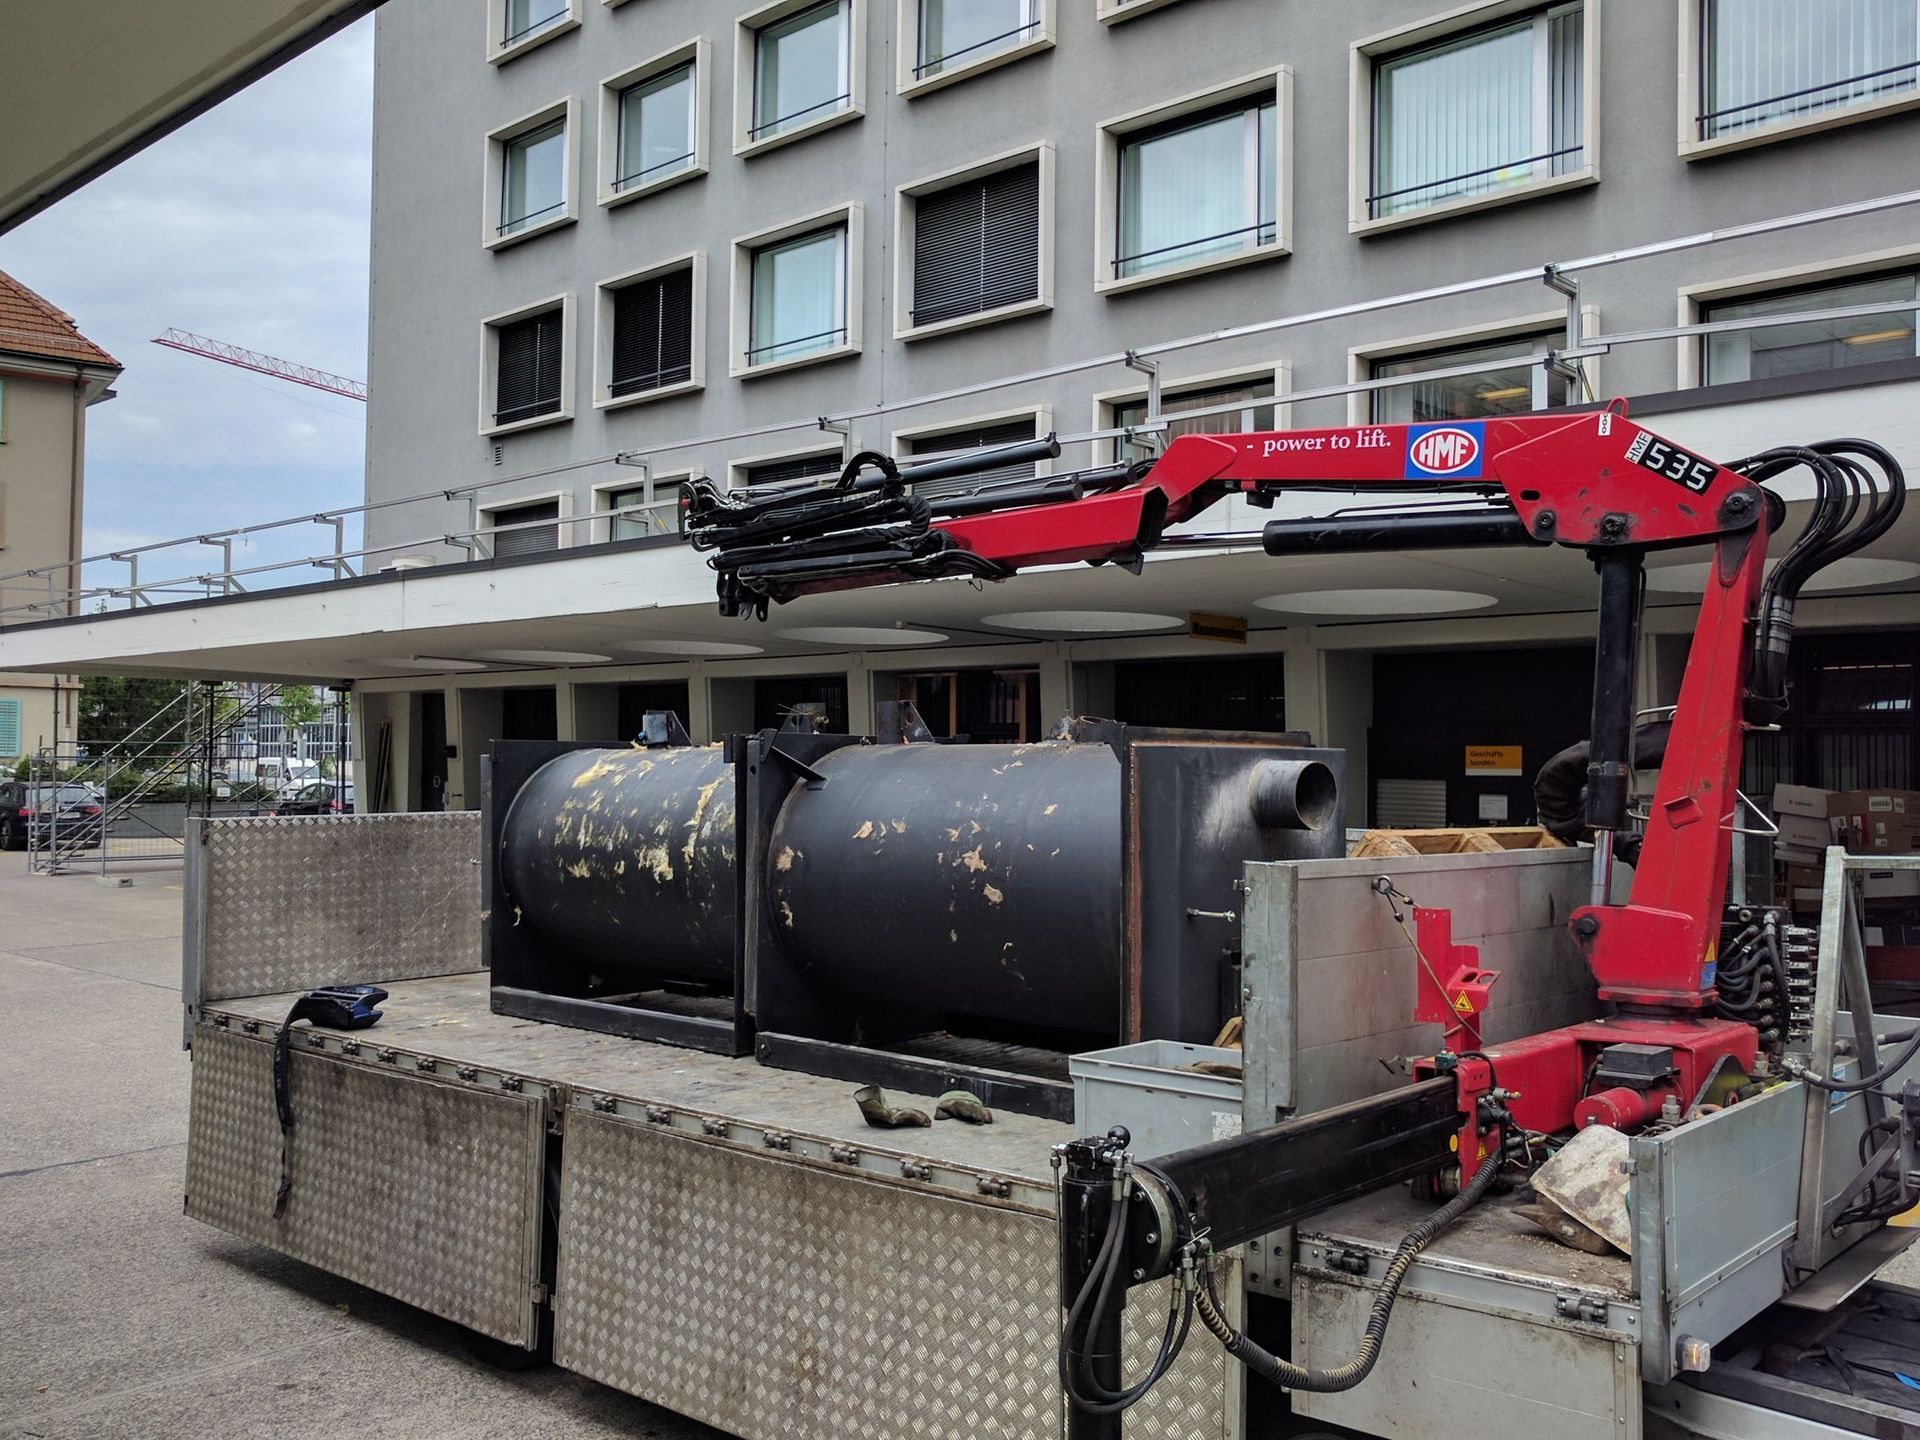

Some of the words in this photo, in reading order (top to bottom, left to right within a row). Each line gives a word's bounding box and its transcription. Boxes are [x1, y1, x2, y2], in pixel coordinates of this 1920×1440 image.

[1262, 435, 1326, 457] power
[1330, 434, 1351, 450] to
[1355, 429, 1392, 449] lift.
[1418, 434, 1470, 468] HMF
[1627, 432, 1649, 463] HMF
[1645, 441, 1713, 491] 535
[1470, 759, 1496, 767] kunden
